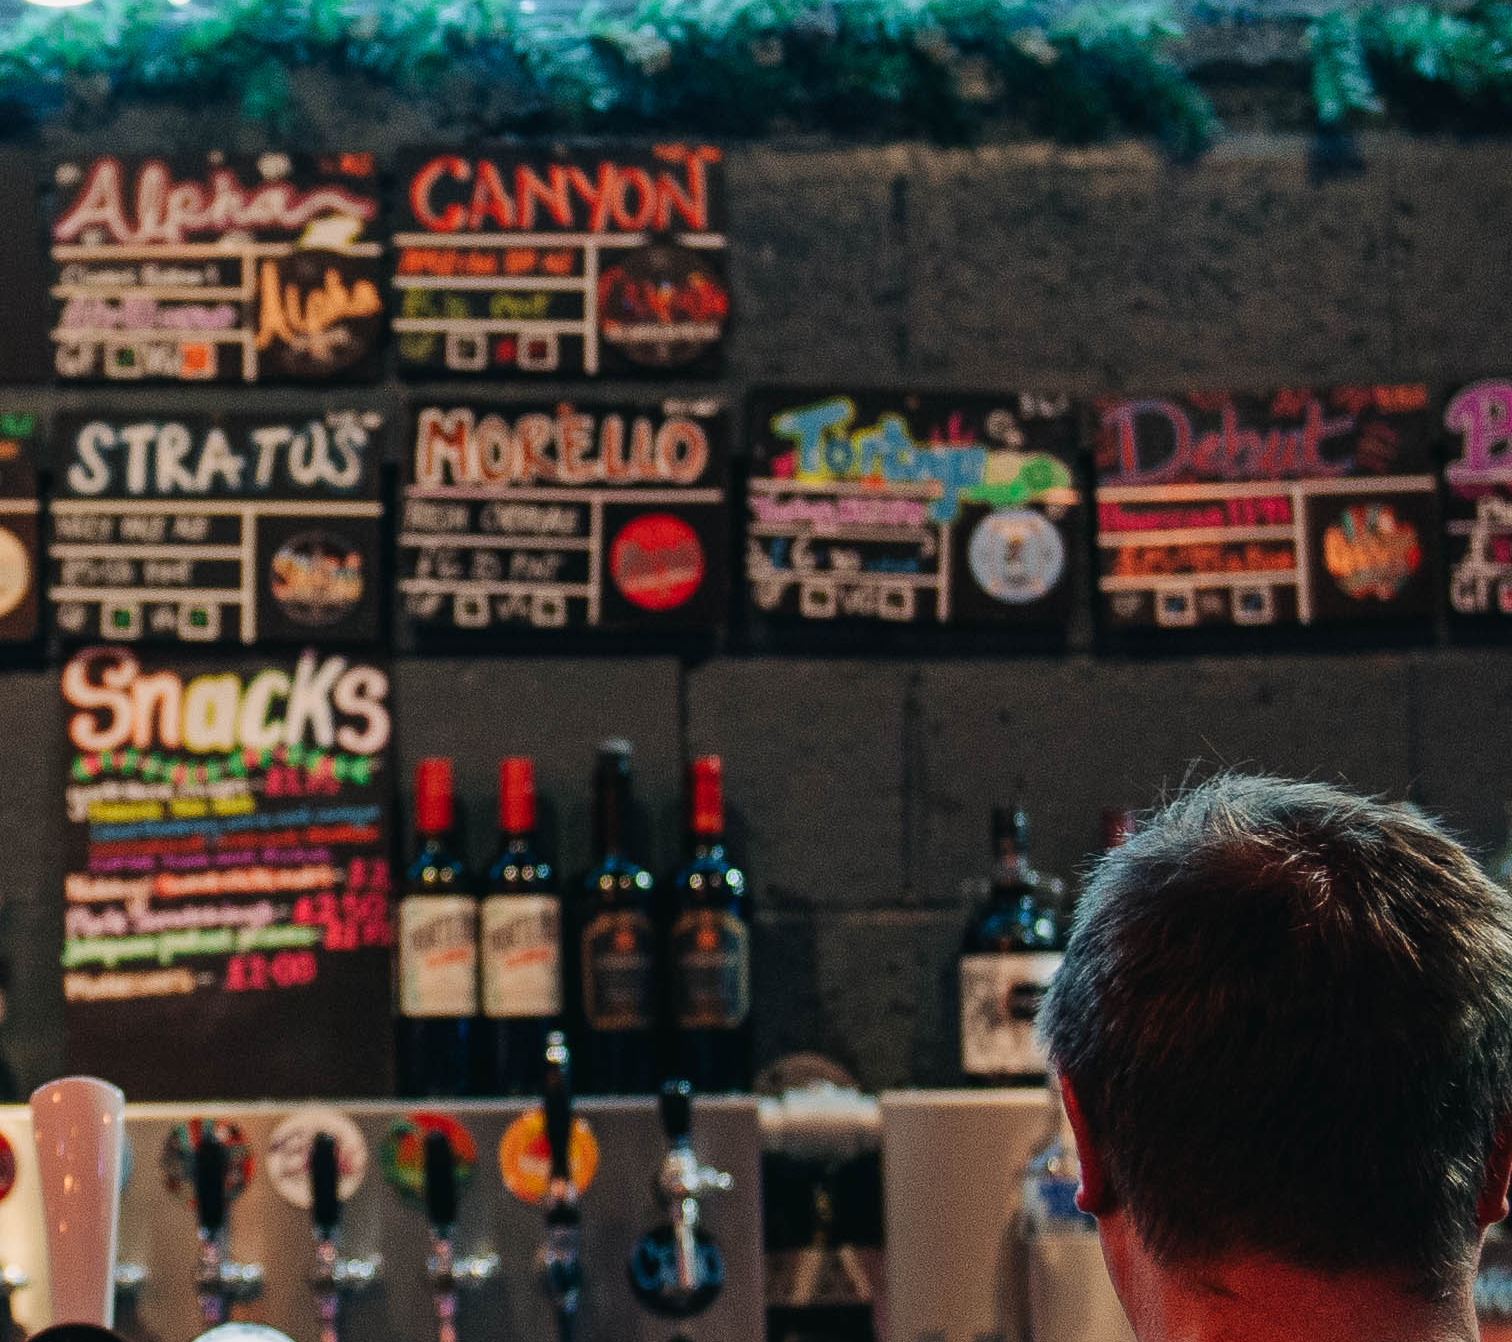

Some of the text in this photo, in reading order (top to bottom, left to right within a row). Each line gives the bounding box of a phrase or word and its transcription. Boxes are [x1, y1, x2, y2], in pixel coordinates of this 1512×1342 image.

[409, 159, 711, 233] CANYON
[67, 421, 372, 494] STRATUS
[418, 407, 710, 485] MORELLO
[62, 647, 391, 754] Snacks
